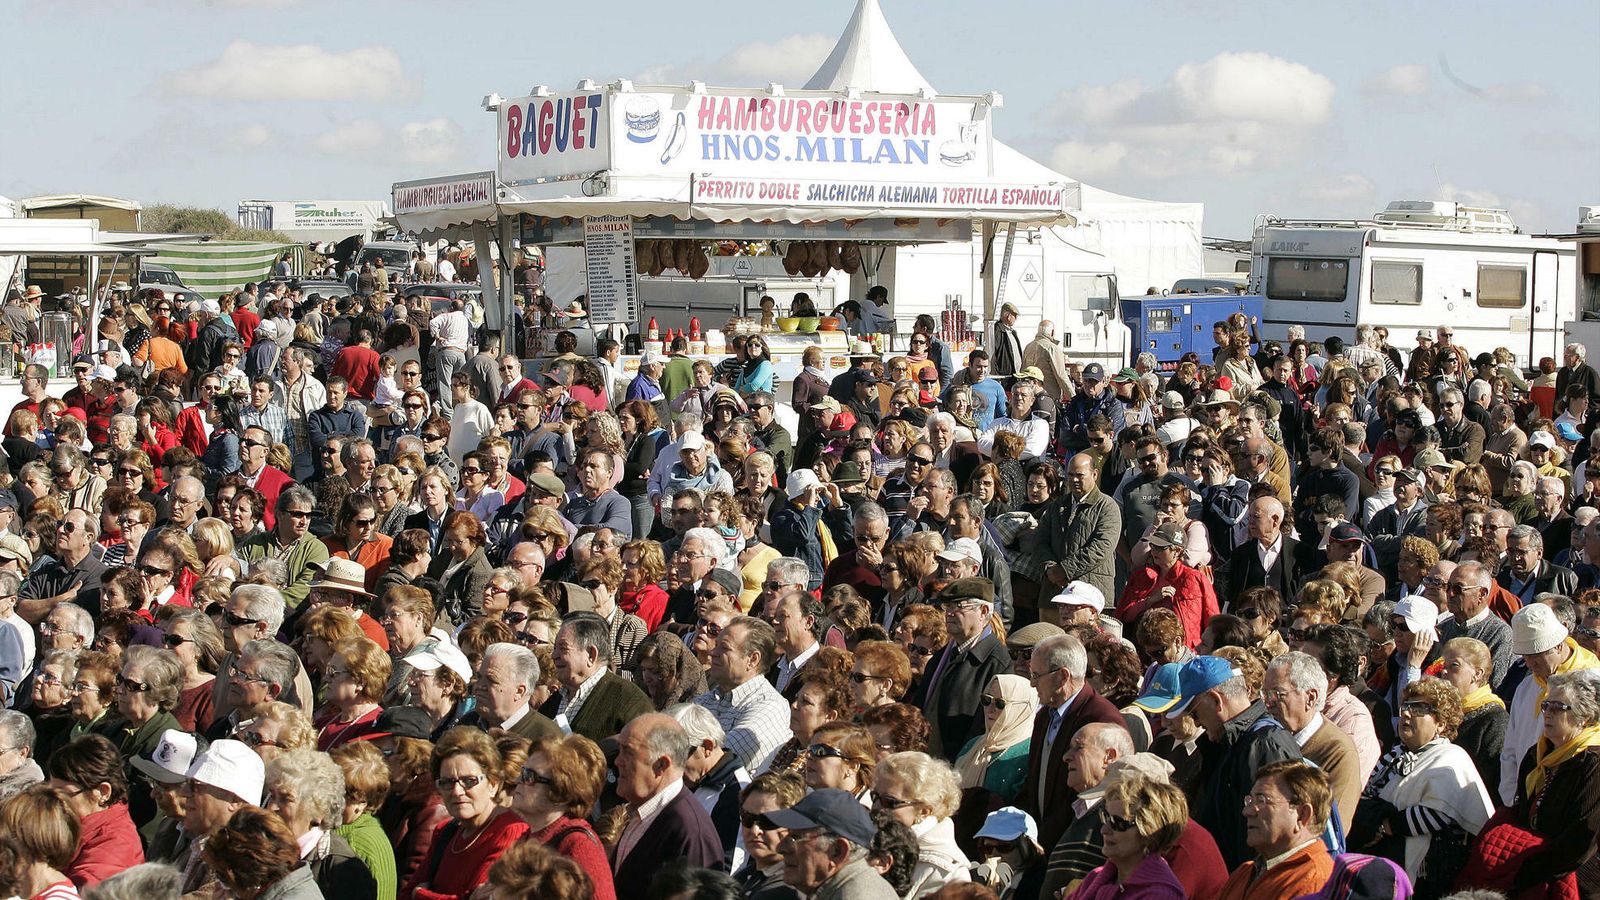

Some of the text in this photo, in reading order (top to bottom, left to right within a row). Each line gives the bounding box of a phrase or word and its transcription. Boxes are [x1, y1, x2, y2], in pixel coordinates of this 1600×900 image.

[507, 94, 602, 159] BAGUET
[698, 96, 936, 138] HAMBURGUESERIA
[396, 181, 488, 209] HAMBURGUESA ESPECIAL
[698, 180, 1061, 206] PERRITO DOBLE SALCHICHA ALEMANA TORTILLA ESPAÑOLA
[315, 207, 356, 217] Ruher
